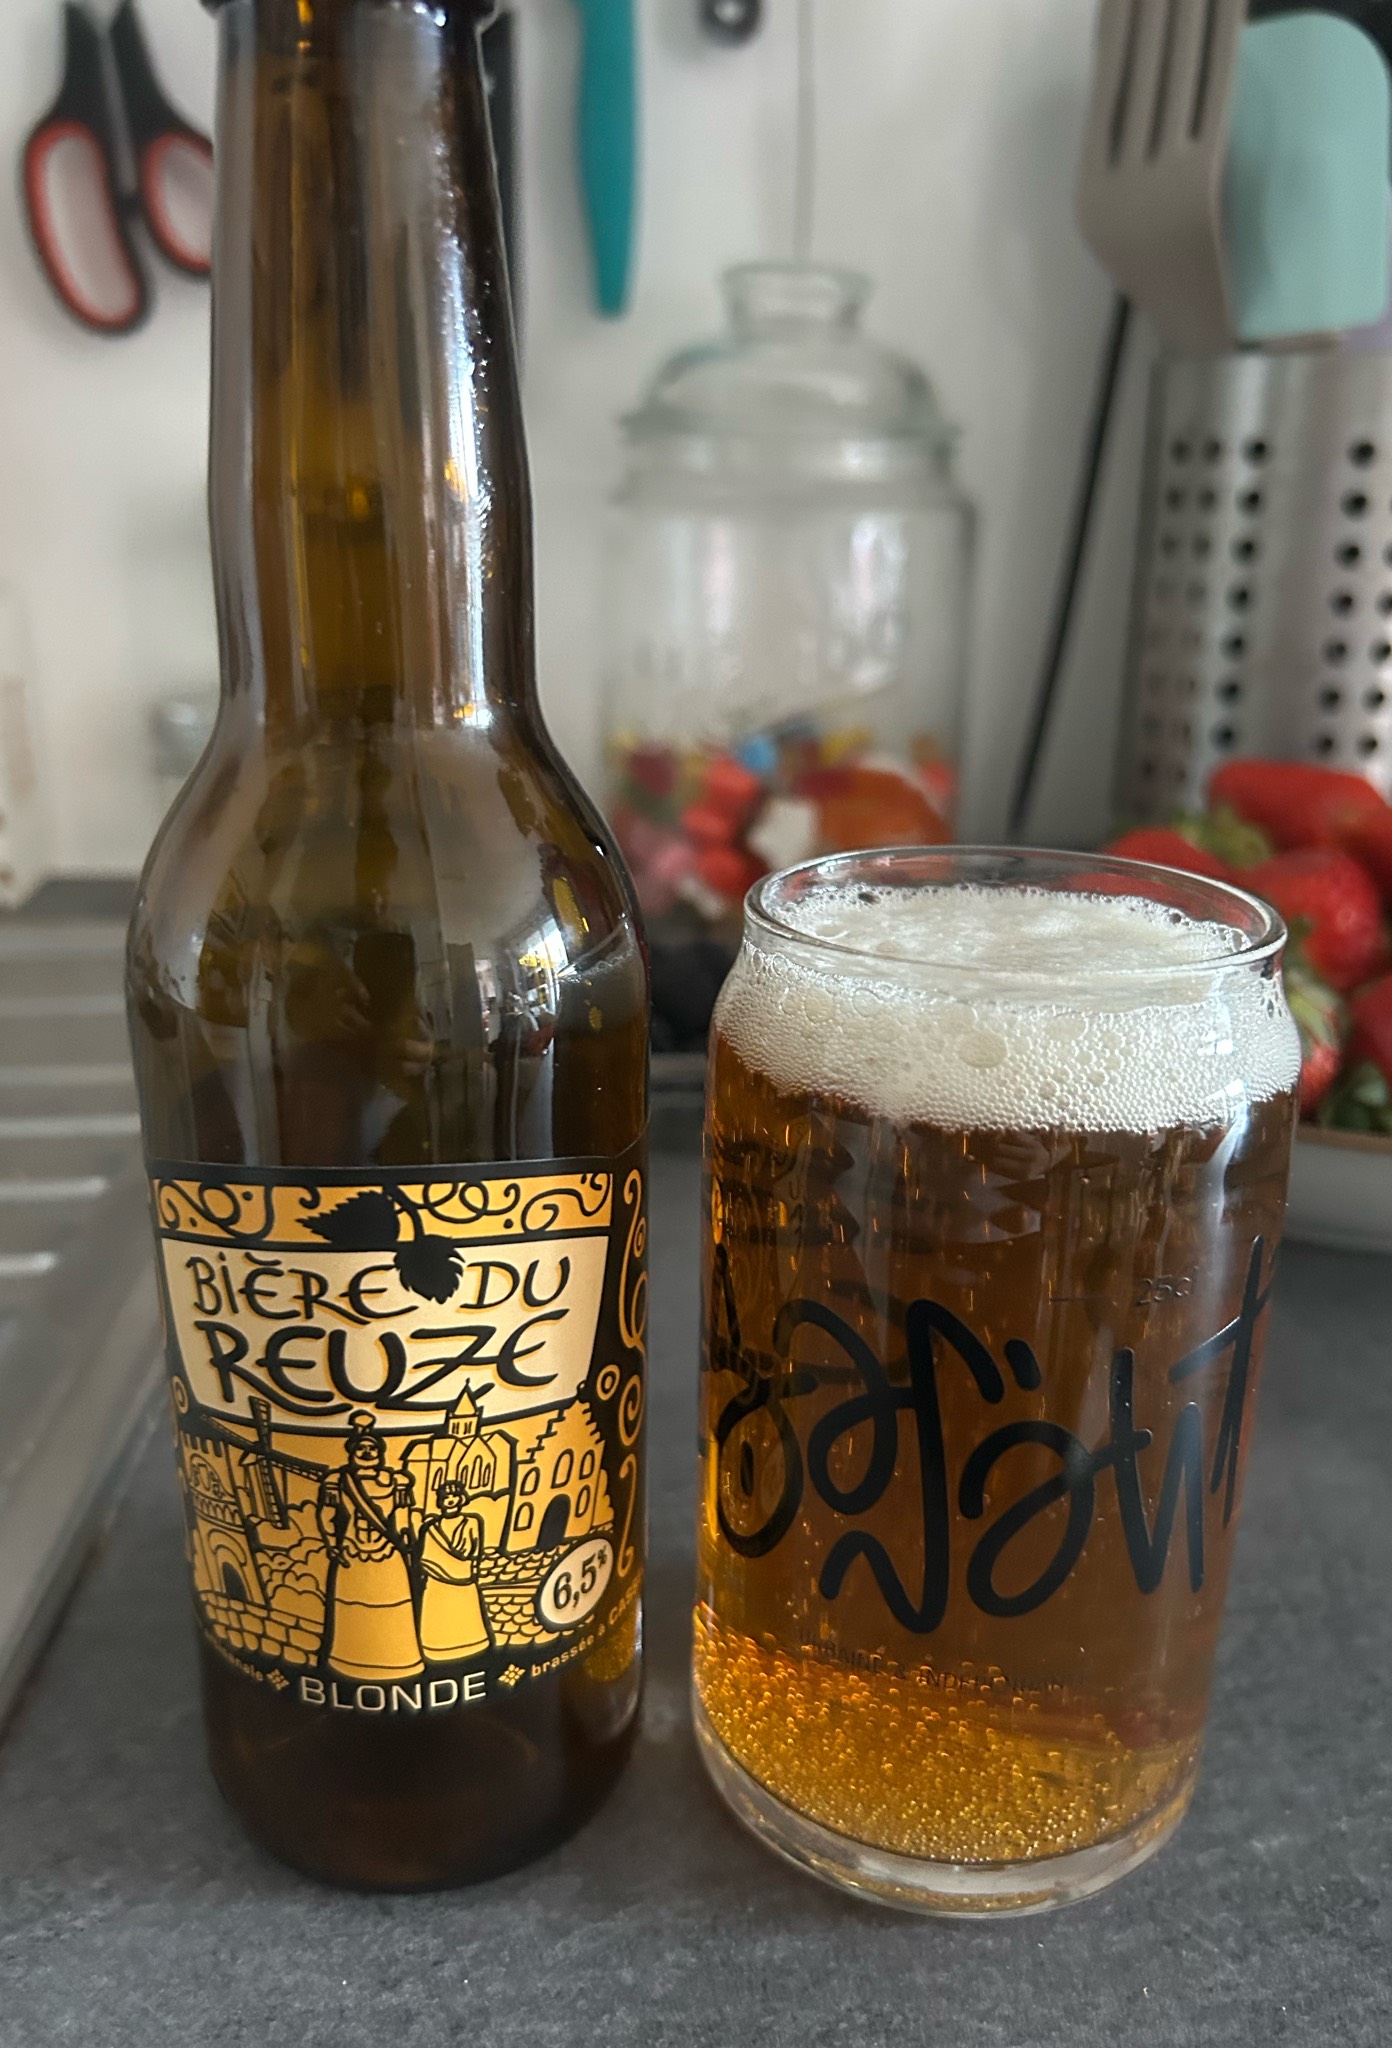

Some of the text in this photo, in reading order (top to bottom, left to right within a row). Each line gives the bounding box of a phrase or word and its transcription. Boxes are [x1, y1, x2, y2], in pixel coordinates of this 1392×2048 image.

[459, 1255, 571, 1310] DU
[194, 1308, 571, 1418] REUZE
[531, 1633, 595, 1677] brassée
[300, 1671, 488, 1712] BLONDE
